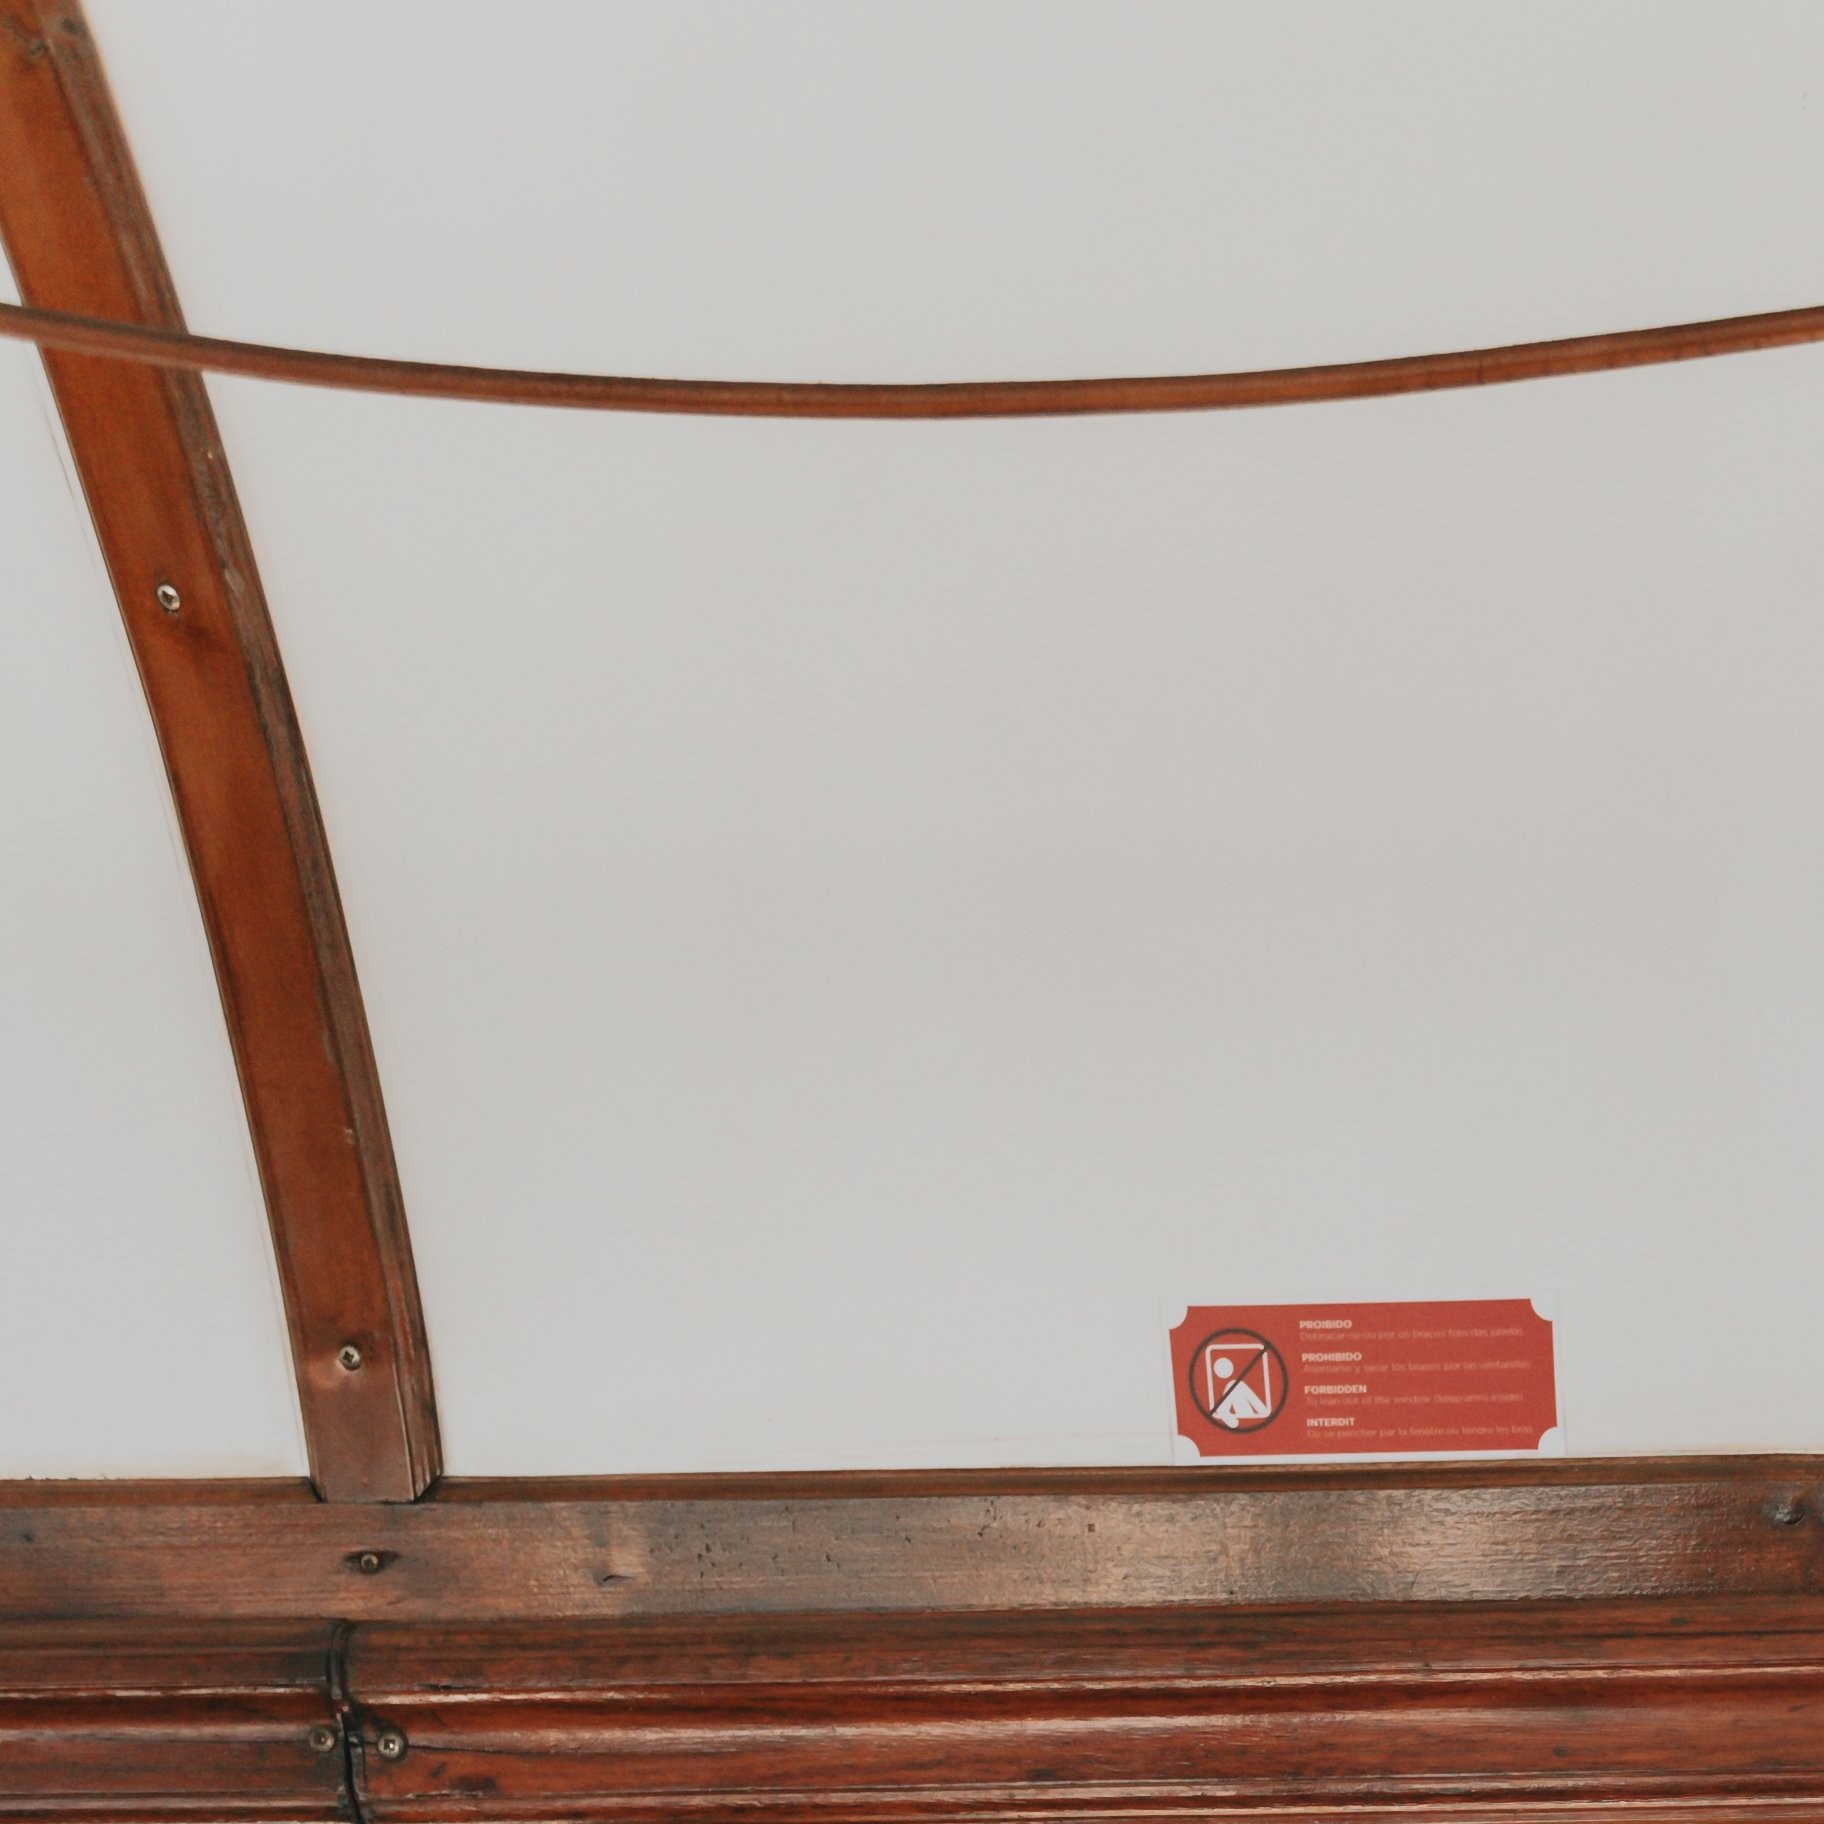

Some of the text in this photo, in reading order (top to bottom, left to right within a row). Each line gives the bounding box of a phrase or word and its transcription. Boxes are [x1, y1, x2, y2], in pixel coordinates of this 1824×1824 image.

[1299, 1319, 1353, 1330] PROIBIDO
[1301, 1351, 1363, 1362] PROHIBIDO
[1304, 1384, 1368, 1395] FORBIDDEN
[1306, 1417, 1355, 1428] INTERDIT
